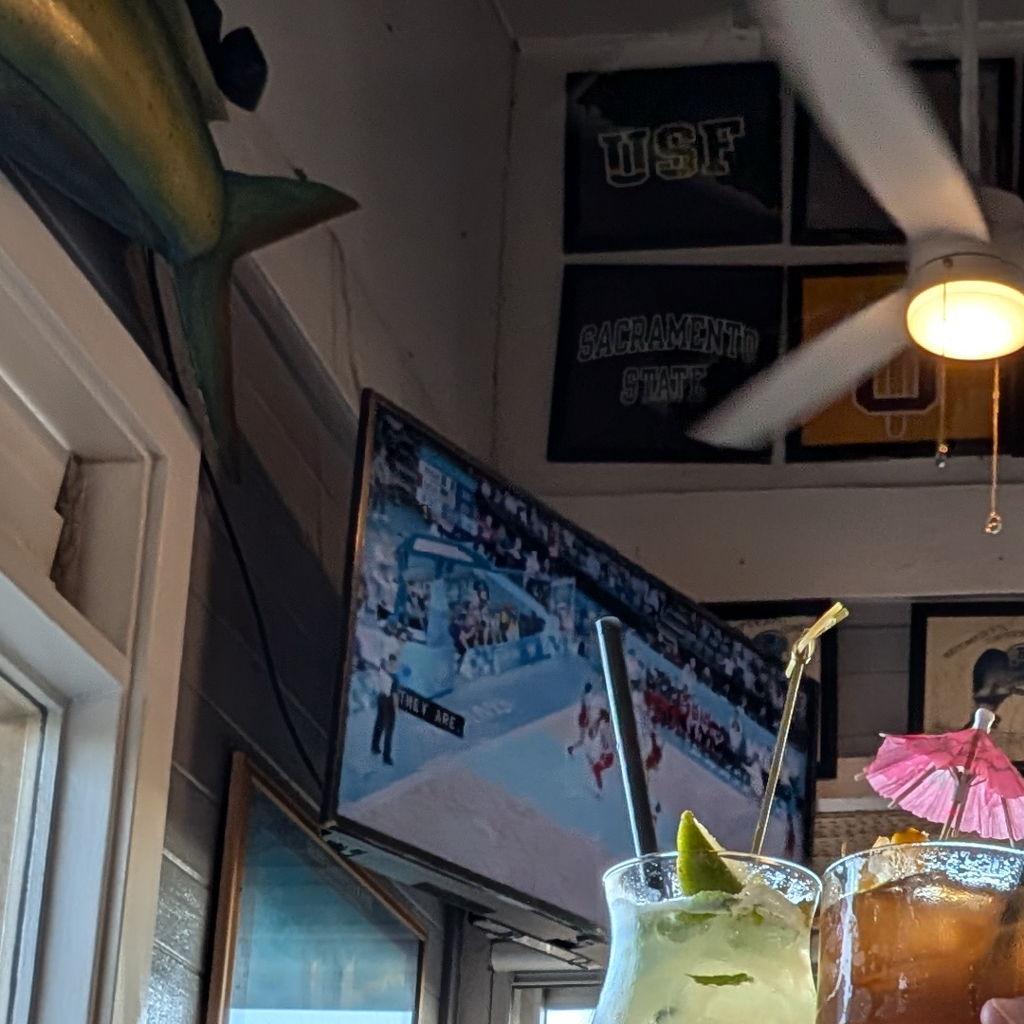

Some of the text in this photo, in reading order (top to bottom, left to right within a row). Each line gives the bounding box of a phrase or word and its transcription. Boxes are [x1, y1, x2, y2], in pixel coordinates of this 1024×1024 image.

[599, 116, 746, 188] USF
[577, 313, 760, 363] SACRAMENTO
[619, 364, 709, 406] STATE
[433, 710, 456, 730] ARE
